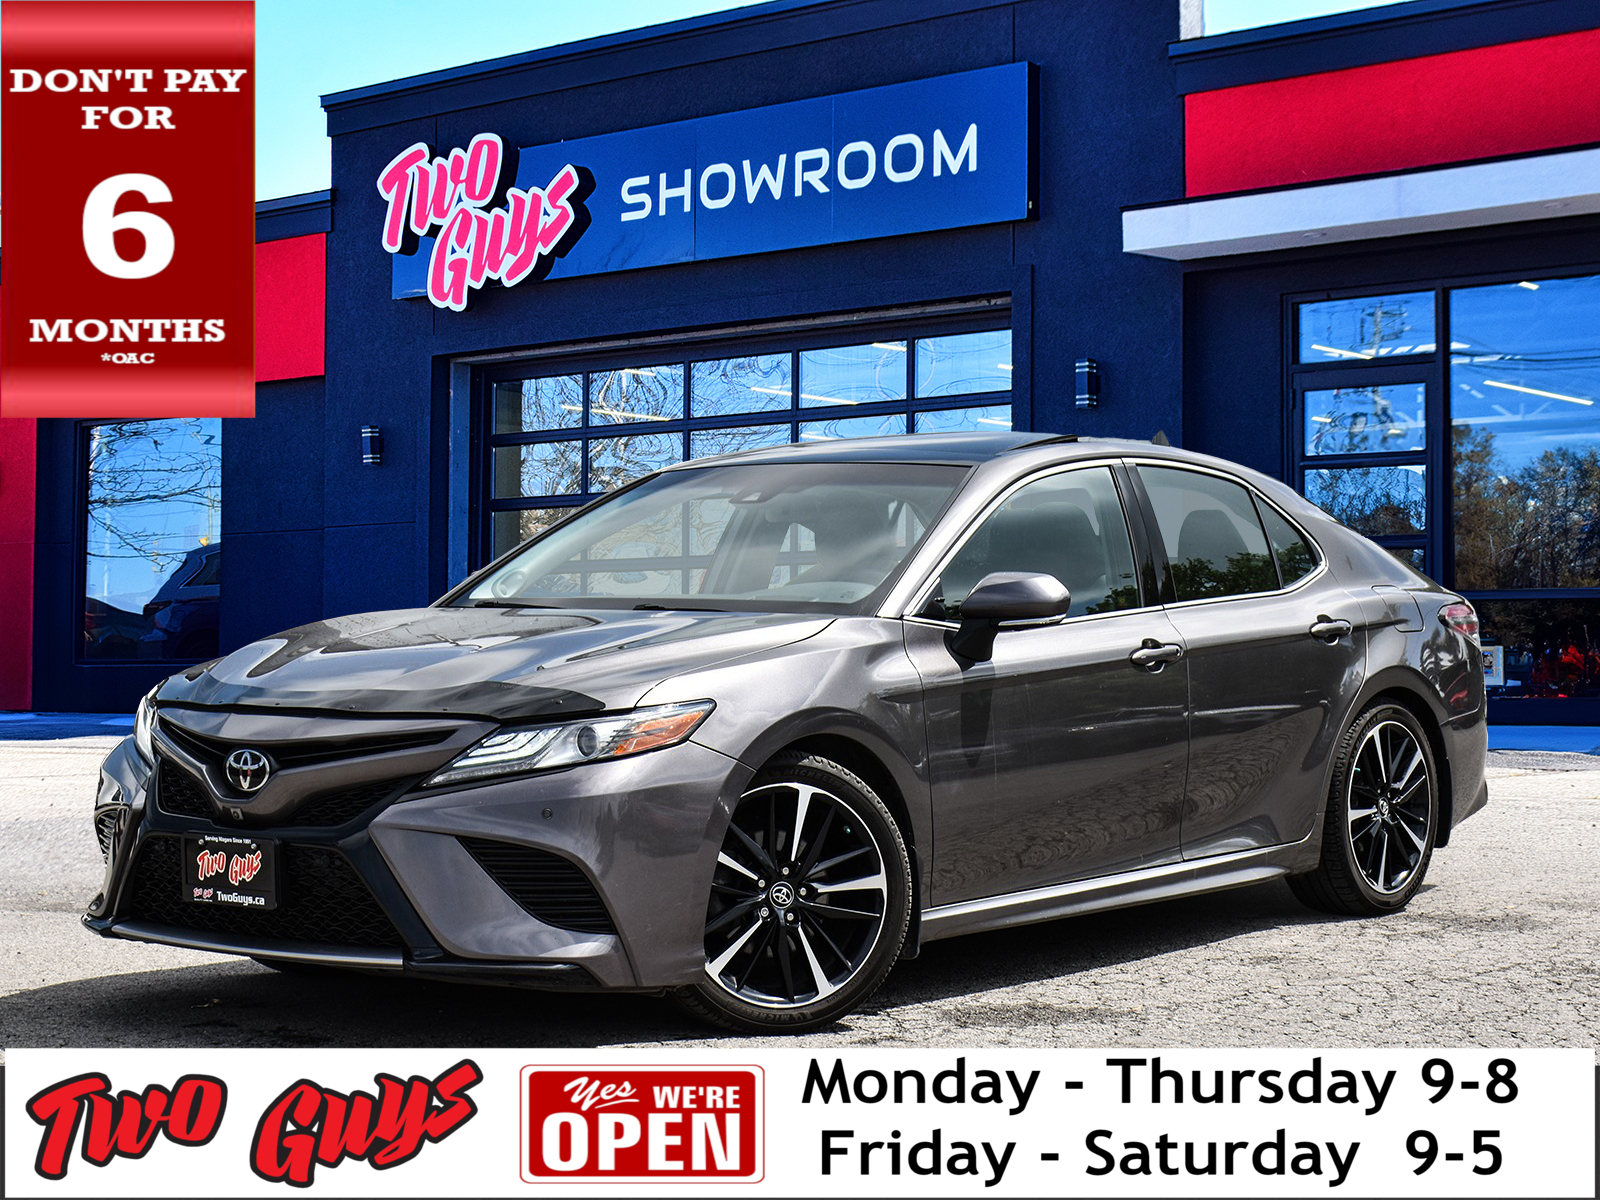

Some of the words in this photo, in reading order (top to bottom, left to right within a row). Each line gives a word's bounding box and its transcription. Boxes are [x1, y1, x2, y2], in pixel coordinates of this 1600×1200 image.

[376, 132, 504, 254] Two
[620, 123, 978, 222] SHOWROOM
[427, 163, 580, 312] Guys
[197, 850, 226, 880] Two
[229, 850, 262, 885] Guys
[216, 891, 265, 906] TwoGuys.ca
